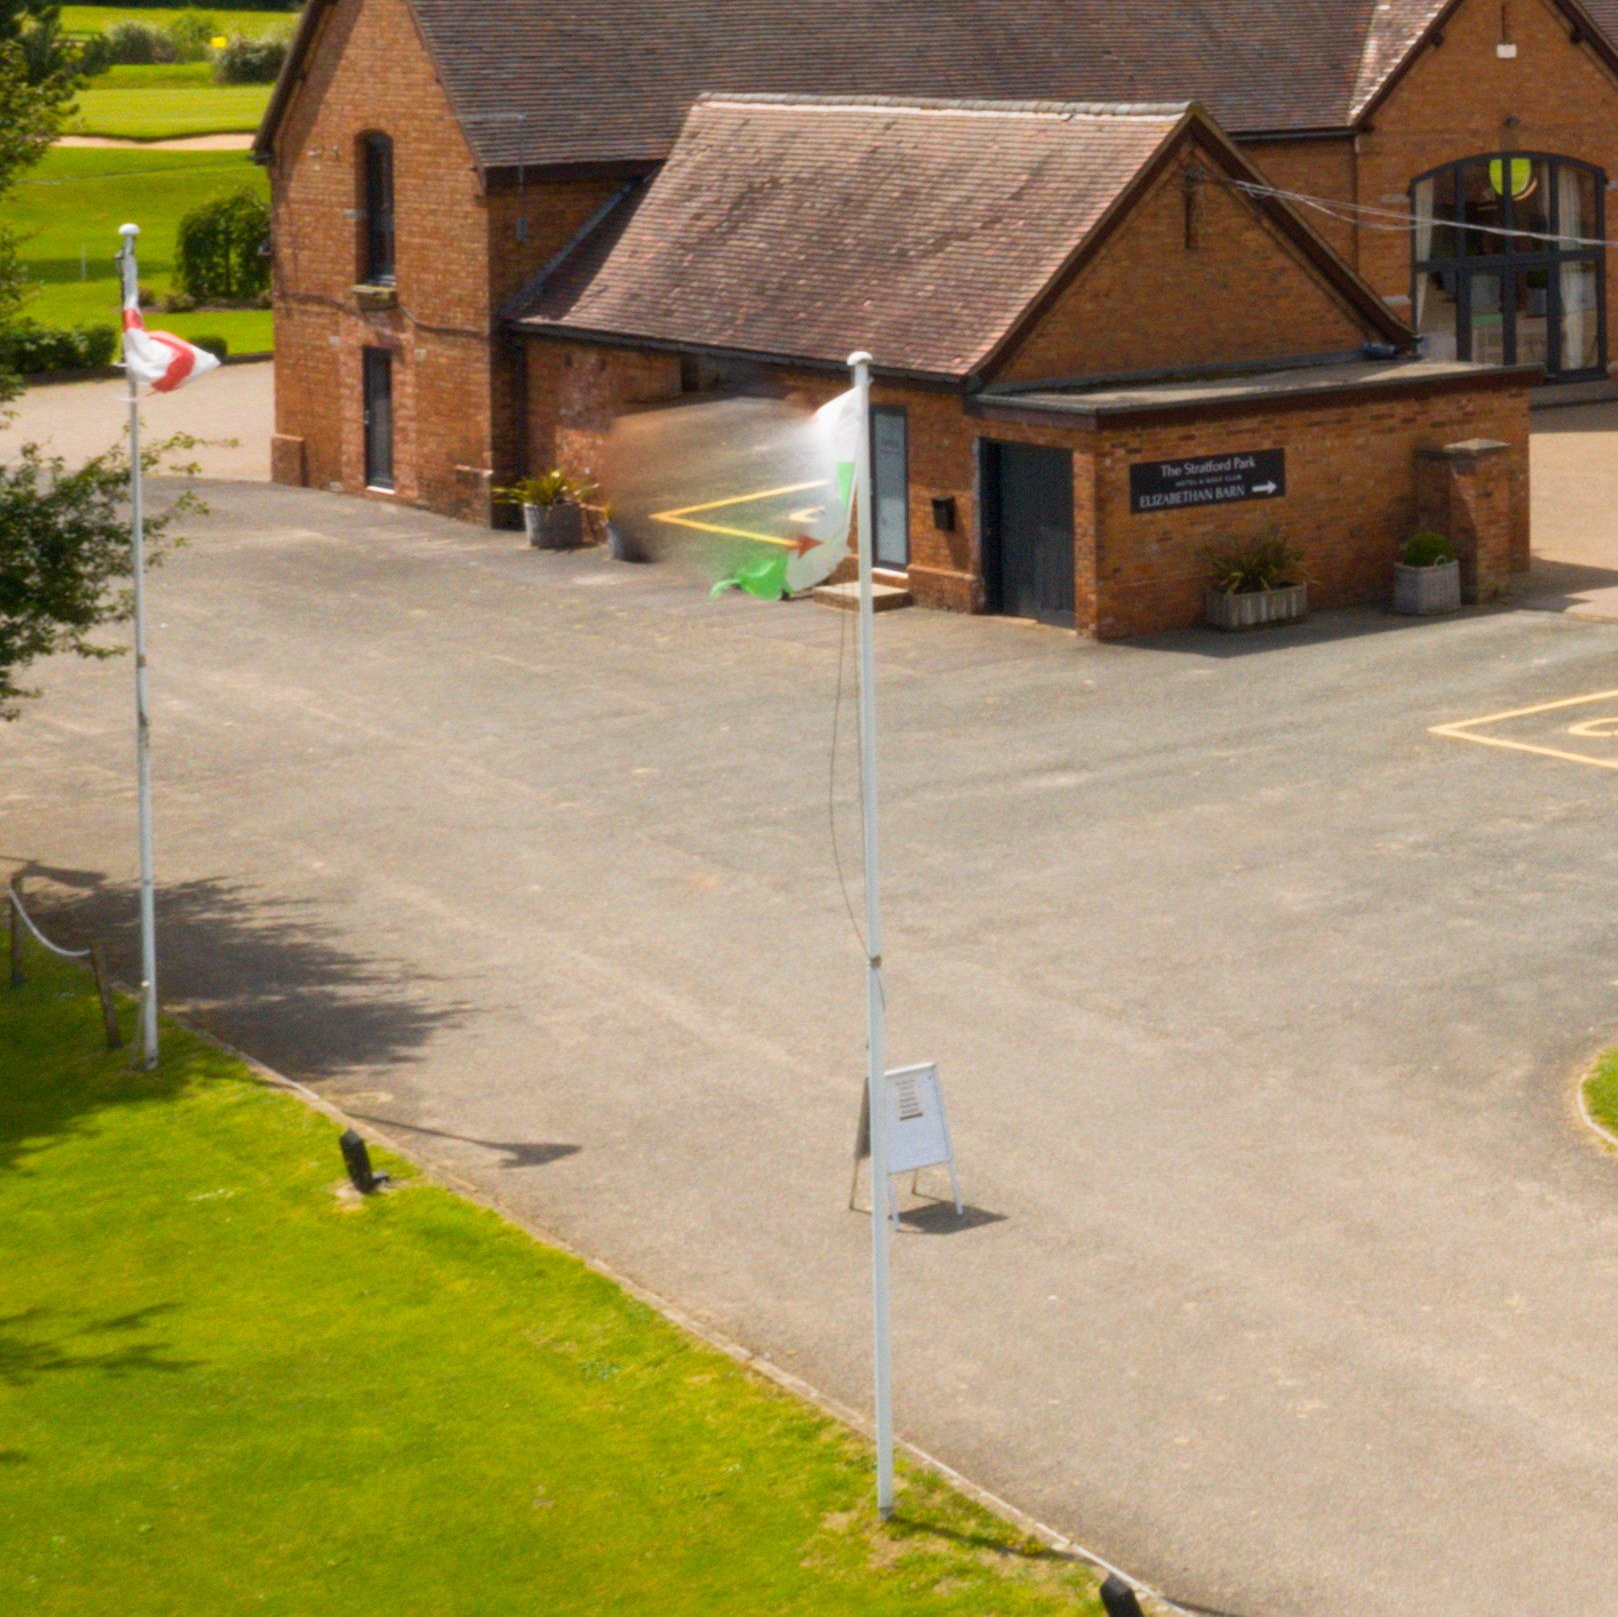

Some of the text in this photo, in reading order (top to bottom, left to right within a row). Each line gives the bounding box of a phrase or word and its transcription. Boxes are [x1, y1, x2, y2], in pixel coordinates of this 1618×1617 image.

[1161, 456, 1255, 478] The Stratford Park
[1139, 485, 1245, 508] ELIZABETHAN BARN
